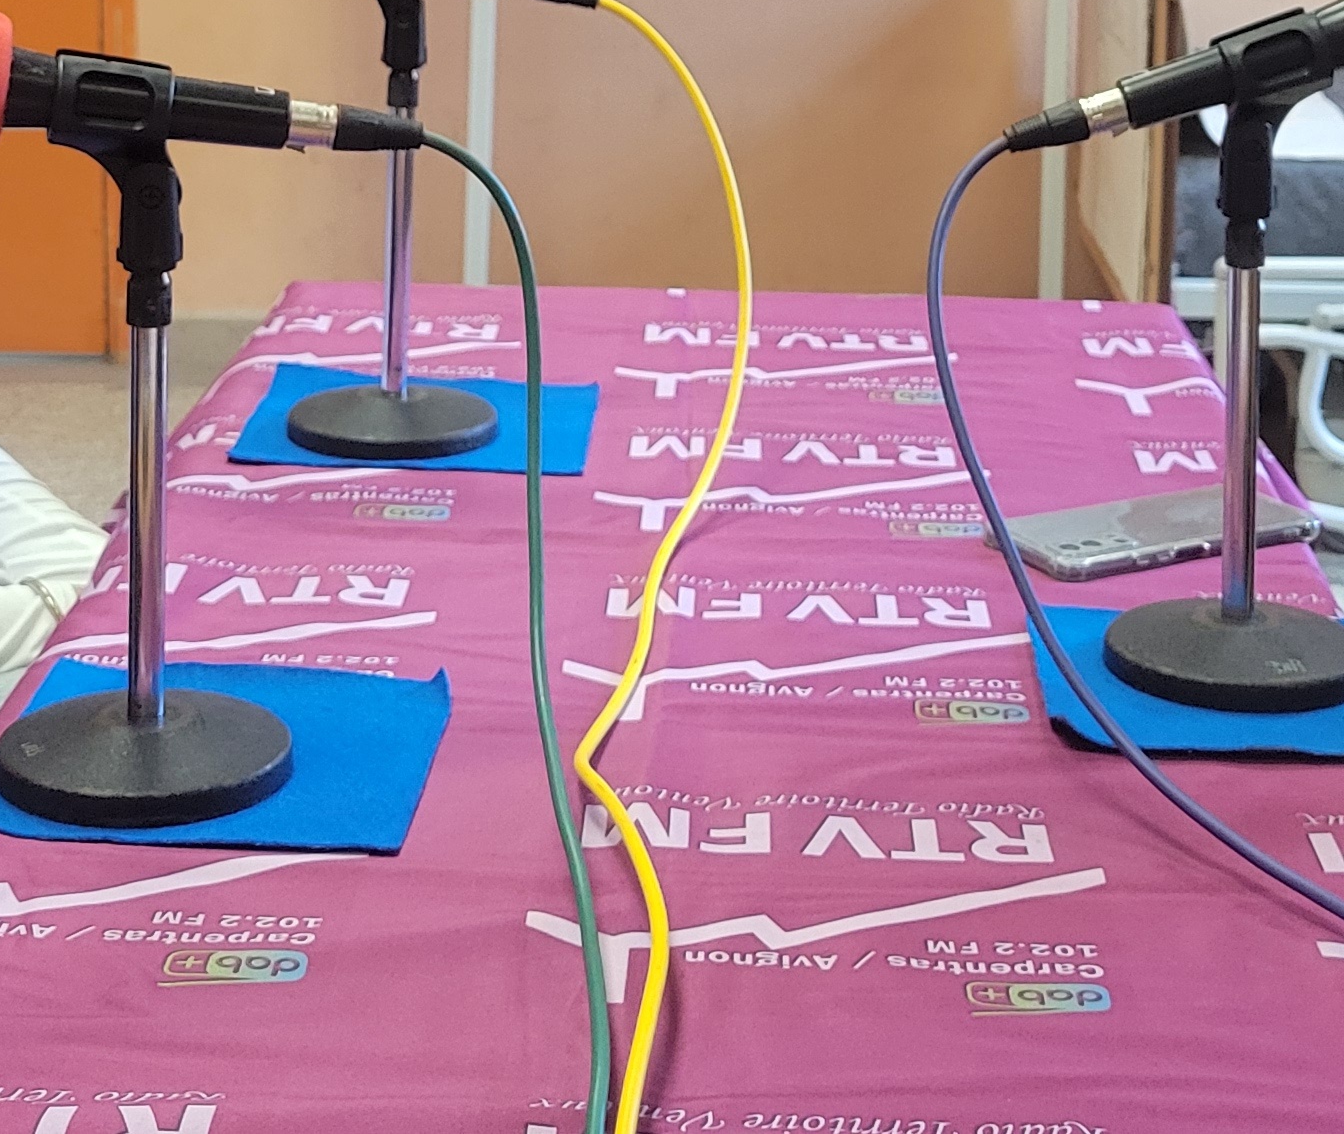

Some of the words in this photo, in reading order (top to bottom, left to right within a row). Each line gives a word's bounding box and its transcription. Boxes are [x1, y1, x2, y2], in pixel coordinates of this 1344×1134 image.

[644, 323, 760, 348] FM
[777, 332, 929, 352] RTV
[628, 435, 763, 461] FM
[781, 439, 957, 468] RTV
[196, 574, 411, 607] RTV
[895, 583, 987, 599] Radio
[606, 586, 762, 621] FM
[786, 593, 993, 630] RTV
[259, 653, 305, 665] FM
[689, 682, 815, 699] Avignon
[884, 676, 928, 689] FM
[938, 677, 1022, 690] 102.2
[852, 686, 1028, 703] Carpentras
[613, 784, 741, 813] Ventou
[753, 793, 926, 816] Territoire
[937, 800, 1046, 821] Radio
[580, 801, 773, 854] FM
[802, 815, 1055, 863] RTV
[151, 909, 206, 927] FM
[219, 913, 323, 929] 102.2
[101, 927, 317, 947] Carpentras
[925, 939, 980, 957] FM
[682, 947, 839, 971] Avignon
[996, 941, 1099, 958] 102.2
[166, 951, 304, 980] dab+
[887, 953, 1106, 980] Carpentras
[970, 985, 1106, 1011] dab+
[743, 1113, 953, 1134] Territoire
